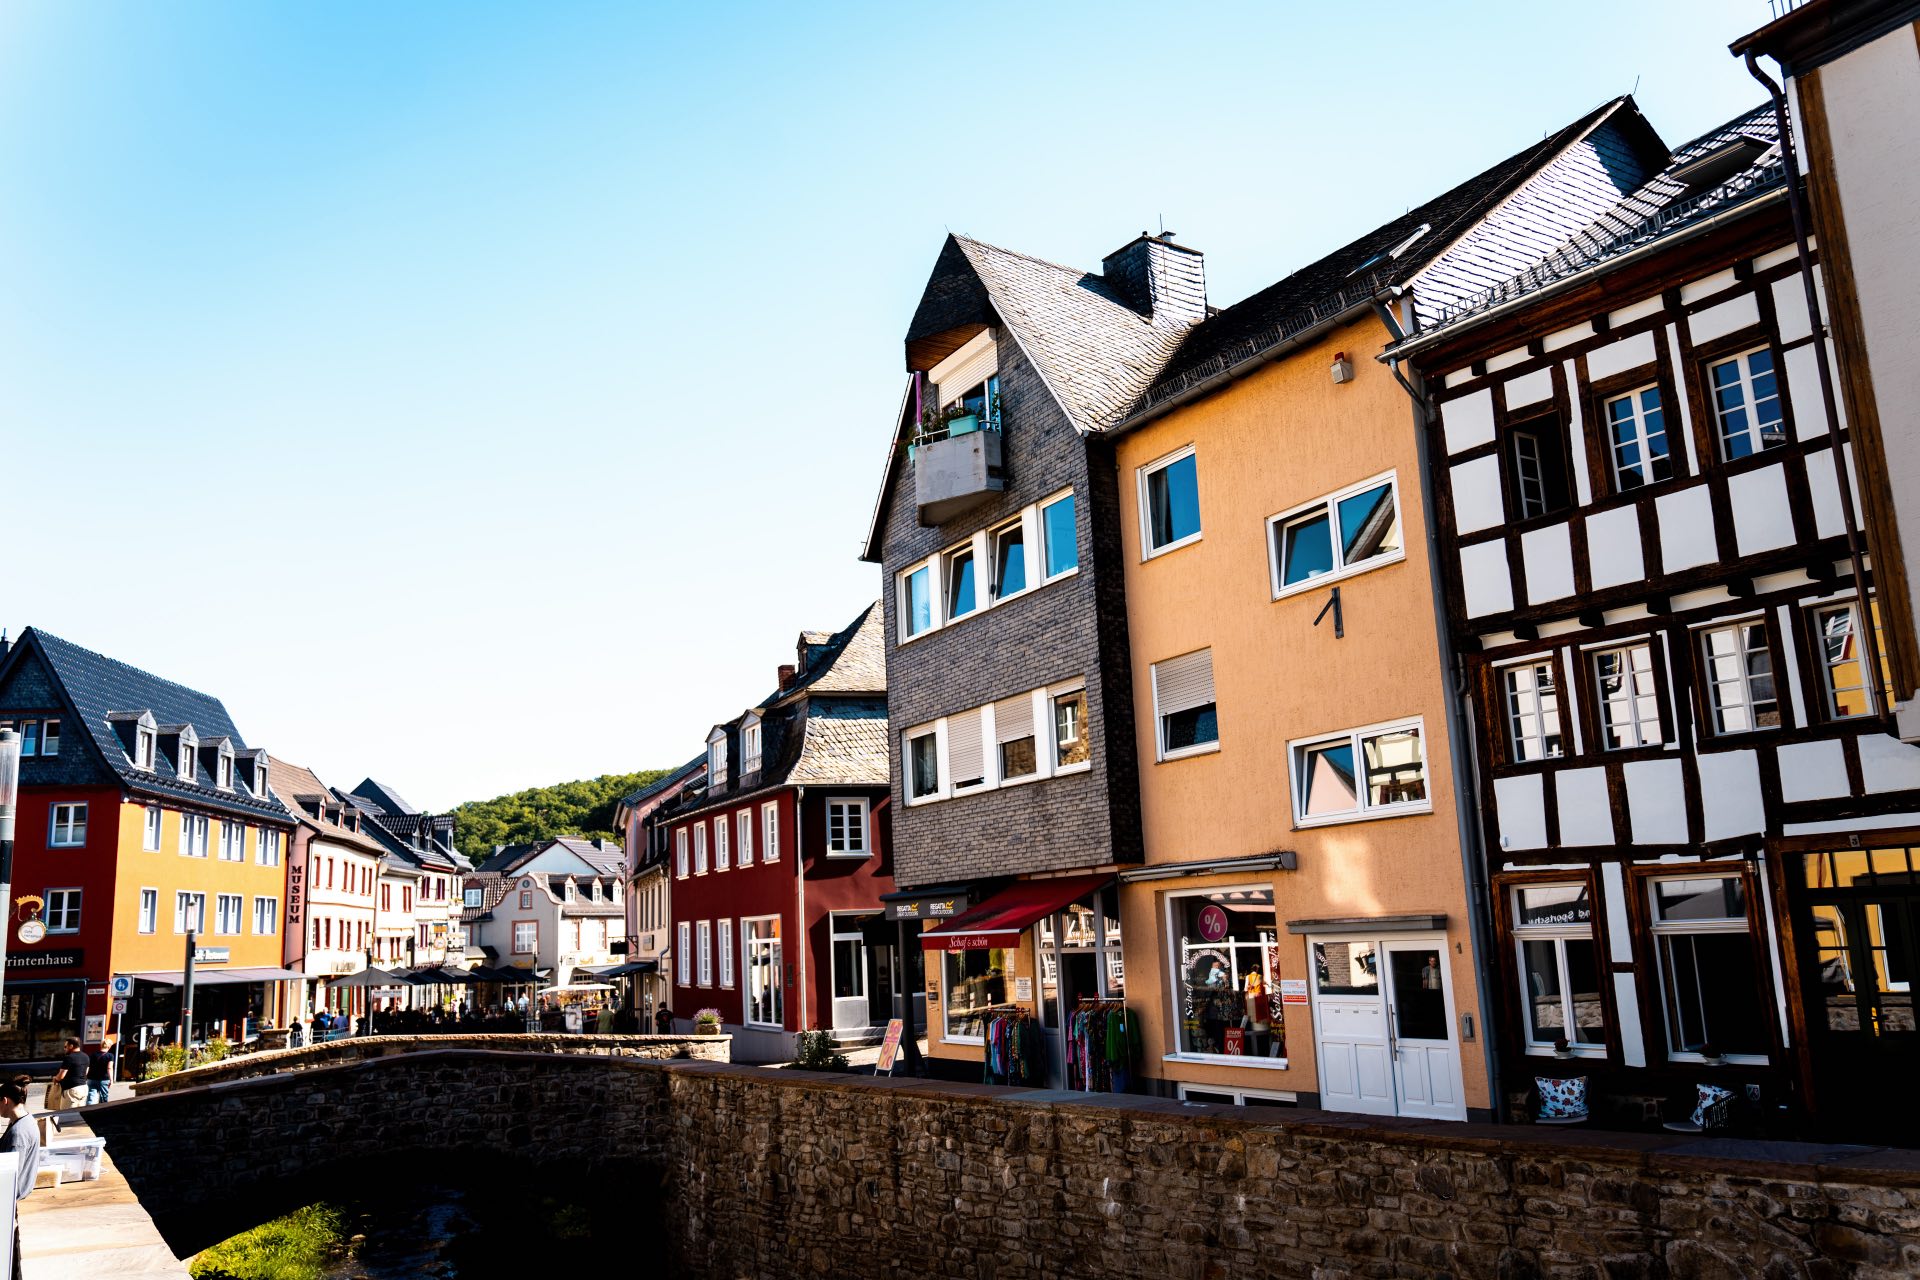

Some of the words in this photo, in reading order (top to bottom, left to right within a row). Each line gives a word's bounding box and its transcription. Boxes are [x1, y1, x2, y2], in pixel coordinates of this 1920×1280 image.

[288, 865, 303, 924] MUSEUM
[1204, 913, 1221, 934] %
[949, 936, 967, 949] Schaf
[971, 936, 988, 946] schön
[5, 953, 74, 967] rintenhaus
[1184, 982, 1194, 1018] Schaf
[1271, 982, 1282, 1021] Schaf
[1227, 1040, 1241, 1056] %
